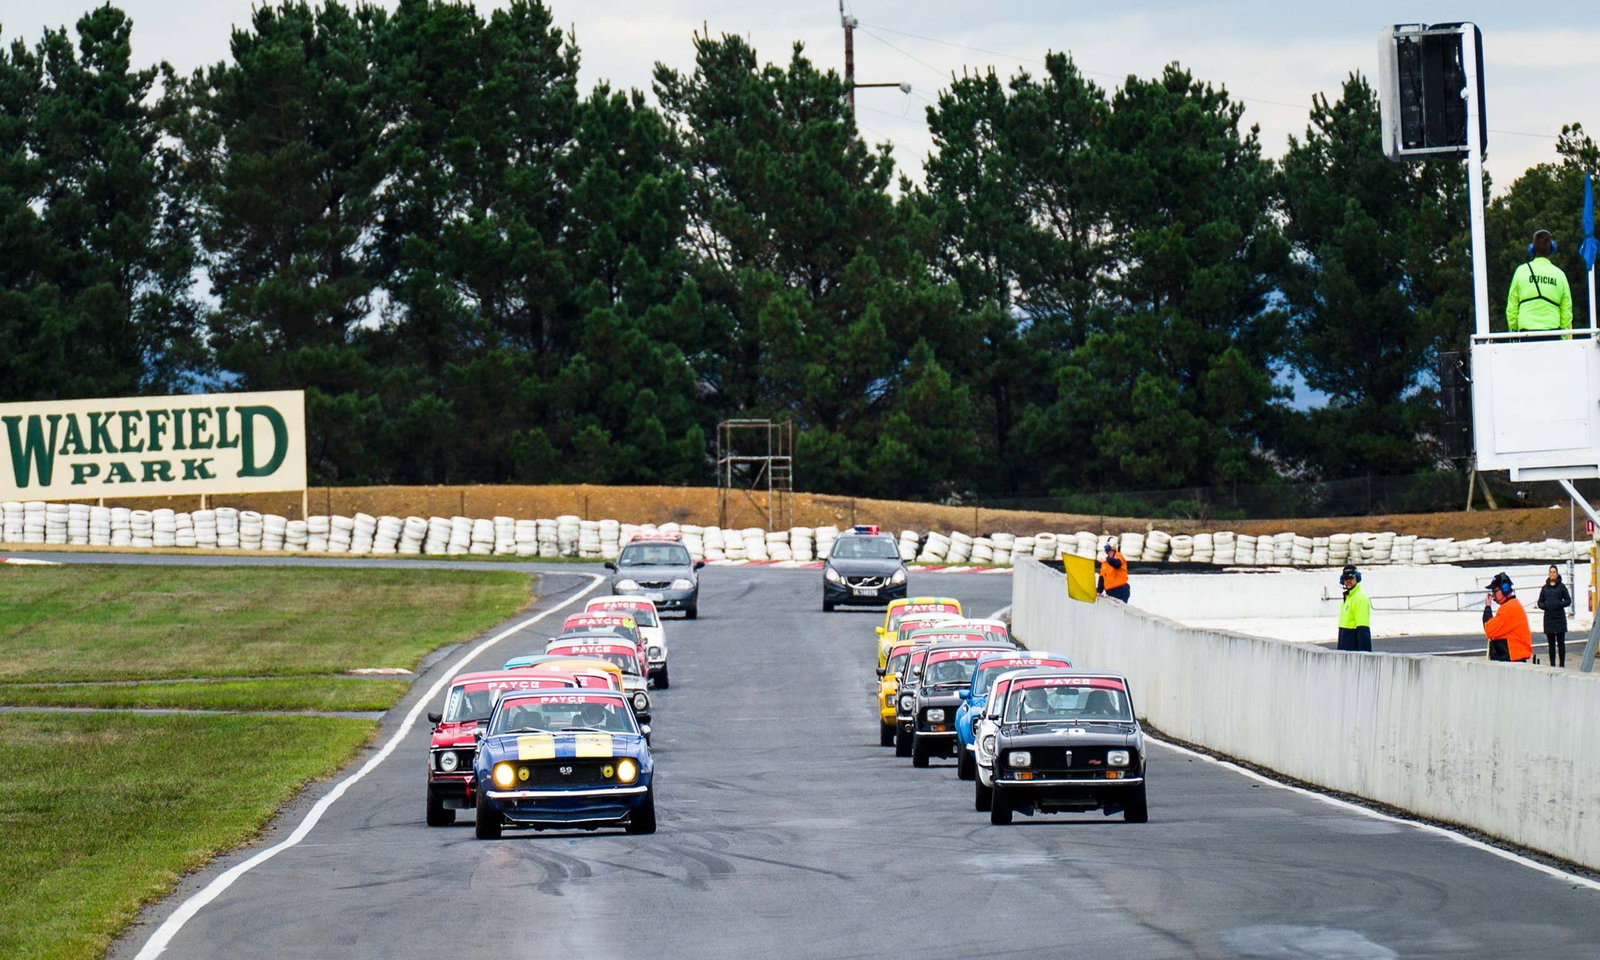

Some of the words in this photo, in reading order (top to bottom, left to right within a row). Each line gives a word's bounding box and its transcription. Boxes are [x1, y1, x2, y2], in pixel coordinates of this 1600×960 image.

[1, 405, 289, 488] WAKEFIELD
[70, 458, 216, 485] PARK
[904, 604, 945, 612] PAYCE
[571, 646, 611, 654] PAYCE
[488, 681, 540, 690] PAYCE
[540, 696, 586, 704] PAYCE
